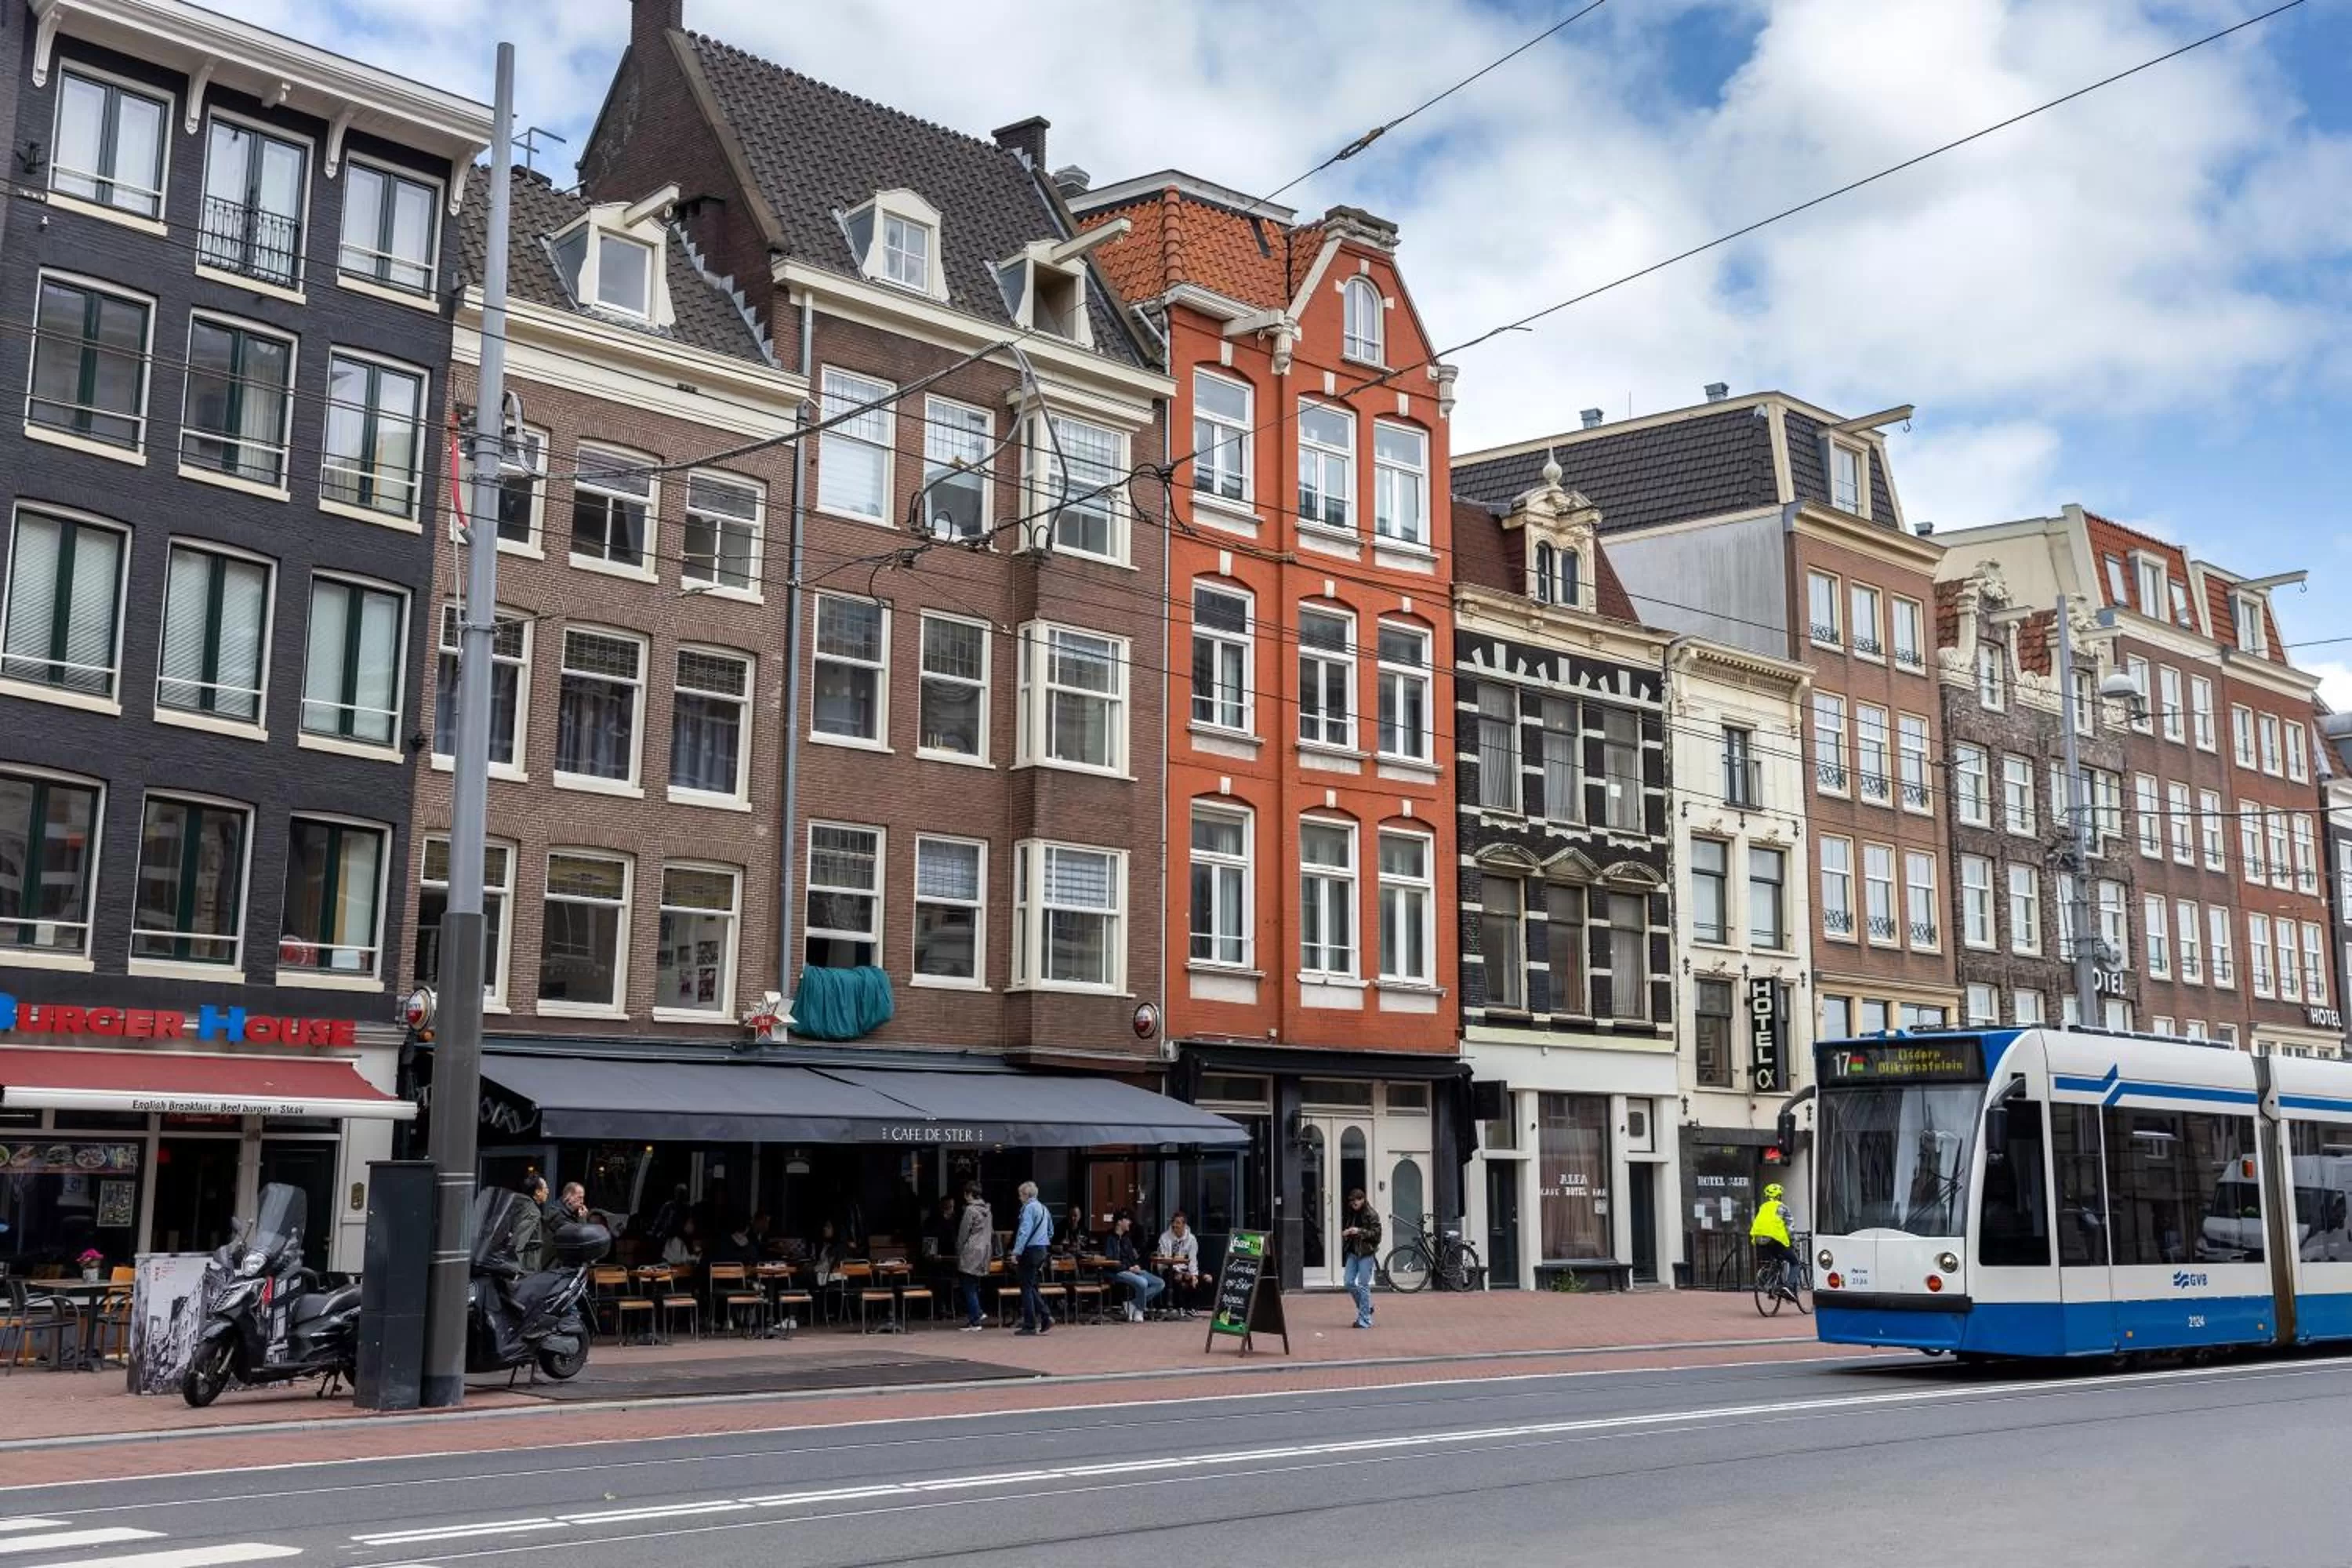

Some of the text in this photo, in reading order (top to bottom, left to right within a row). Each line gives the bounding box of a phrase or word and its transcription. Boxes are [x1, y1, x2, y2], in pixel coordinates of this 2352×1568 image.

[2092, 967, 2126, 995] OTEL
[1752, 981, 1773, 1064] HOTEL
[2310, 1007, 2342, 1027] HOTEL
[1833, 1051, 1851, 1076] 17
[132, 1100, 165, 1110] English
[169, 1102, 211, 1112] Breakfast
[925, 1128, 941, 1142] DE
[945, 1129, 972, 1142] STER
[2190, 1273, 2208, 1287] GVB
